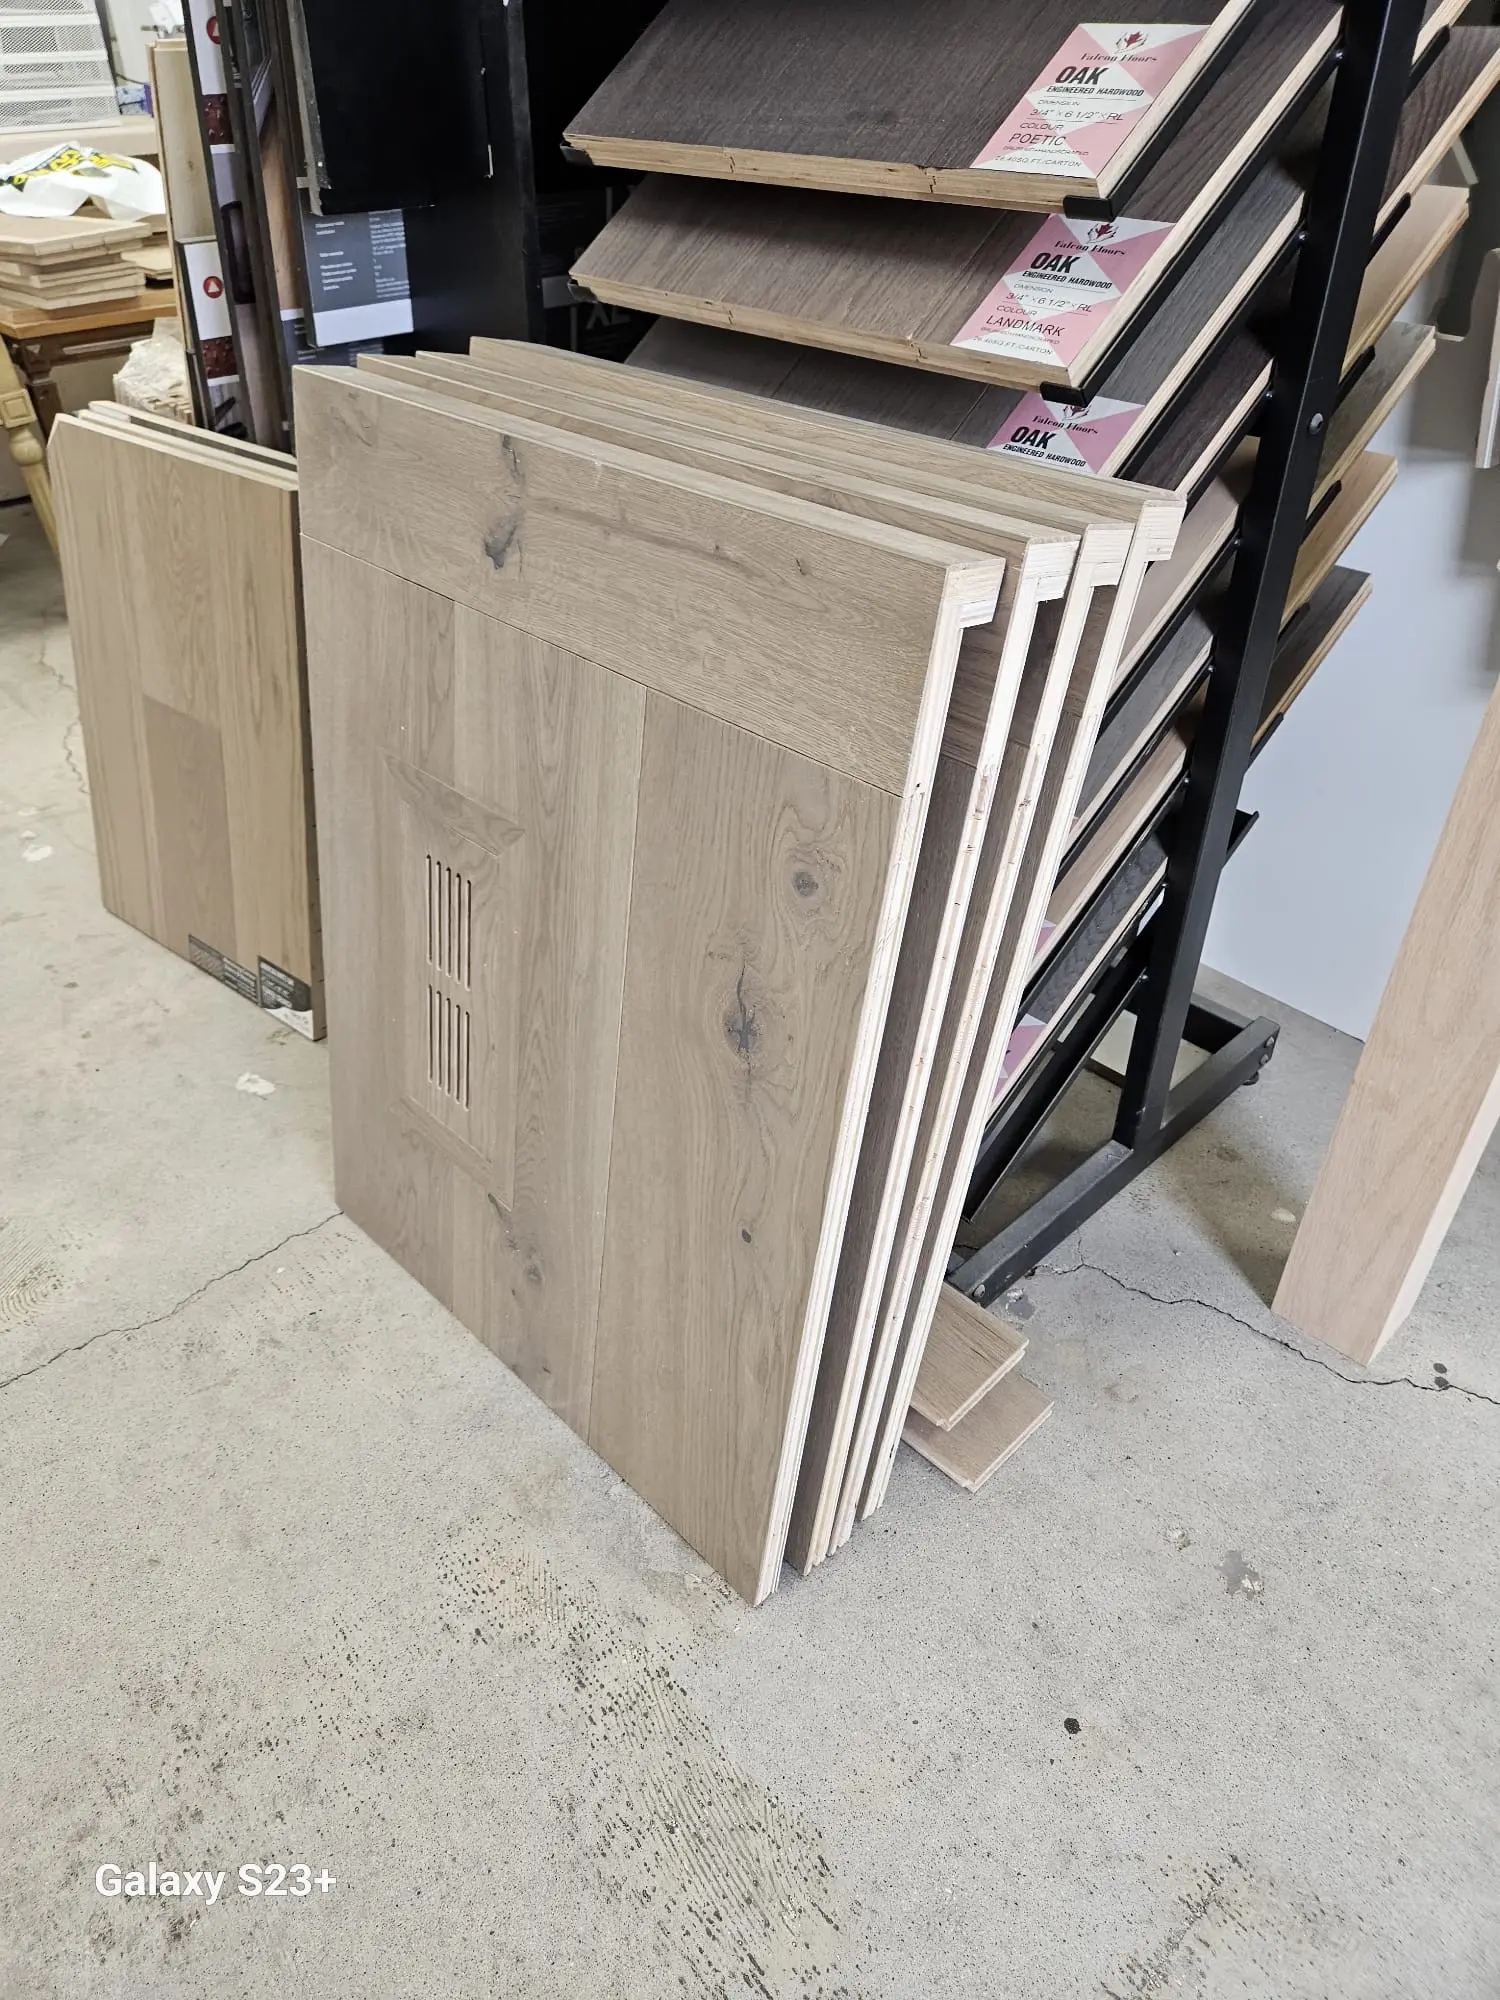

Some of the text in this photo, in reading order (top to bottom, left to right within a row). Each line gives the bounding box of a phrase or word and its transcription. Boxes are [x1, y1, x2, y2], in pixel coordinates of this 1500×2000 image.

[1055, 66, 1110, 85] OAK
[1046, 85, 1145, 97] ENGINEERED HARDWOOD
[1064, 110, 1074, 118] 6
[1106, 112, 1124, 121] RL
[1019, 122, 1065, 131] COLOUR
[1008, 133, 1067, 146] POETIC
[1054, 240, 1126, 256] Falcon Floors
[1030, 252, 1081, 274] OAK
[1022, 270, 1112, 289] ENGINEERED HARDWOOD
[995, 304, 1038, 316] COLOUR
[1076, 303, 1094, 313] RL
[985, 315, 1066, 337] LANDMARK
[1032, 415, 1099, 435] Falcon Floors
[1010, 426, 1057, 450] OAK
[1002, 443, 1086, 467] ENGINEERED HARDWOOD
